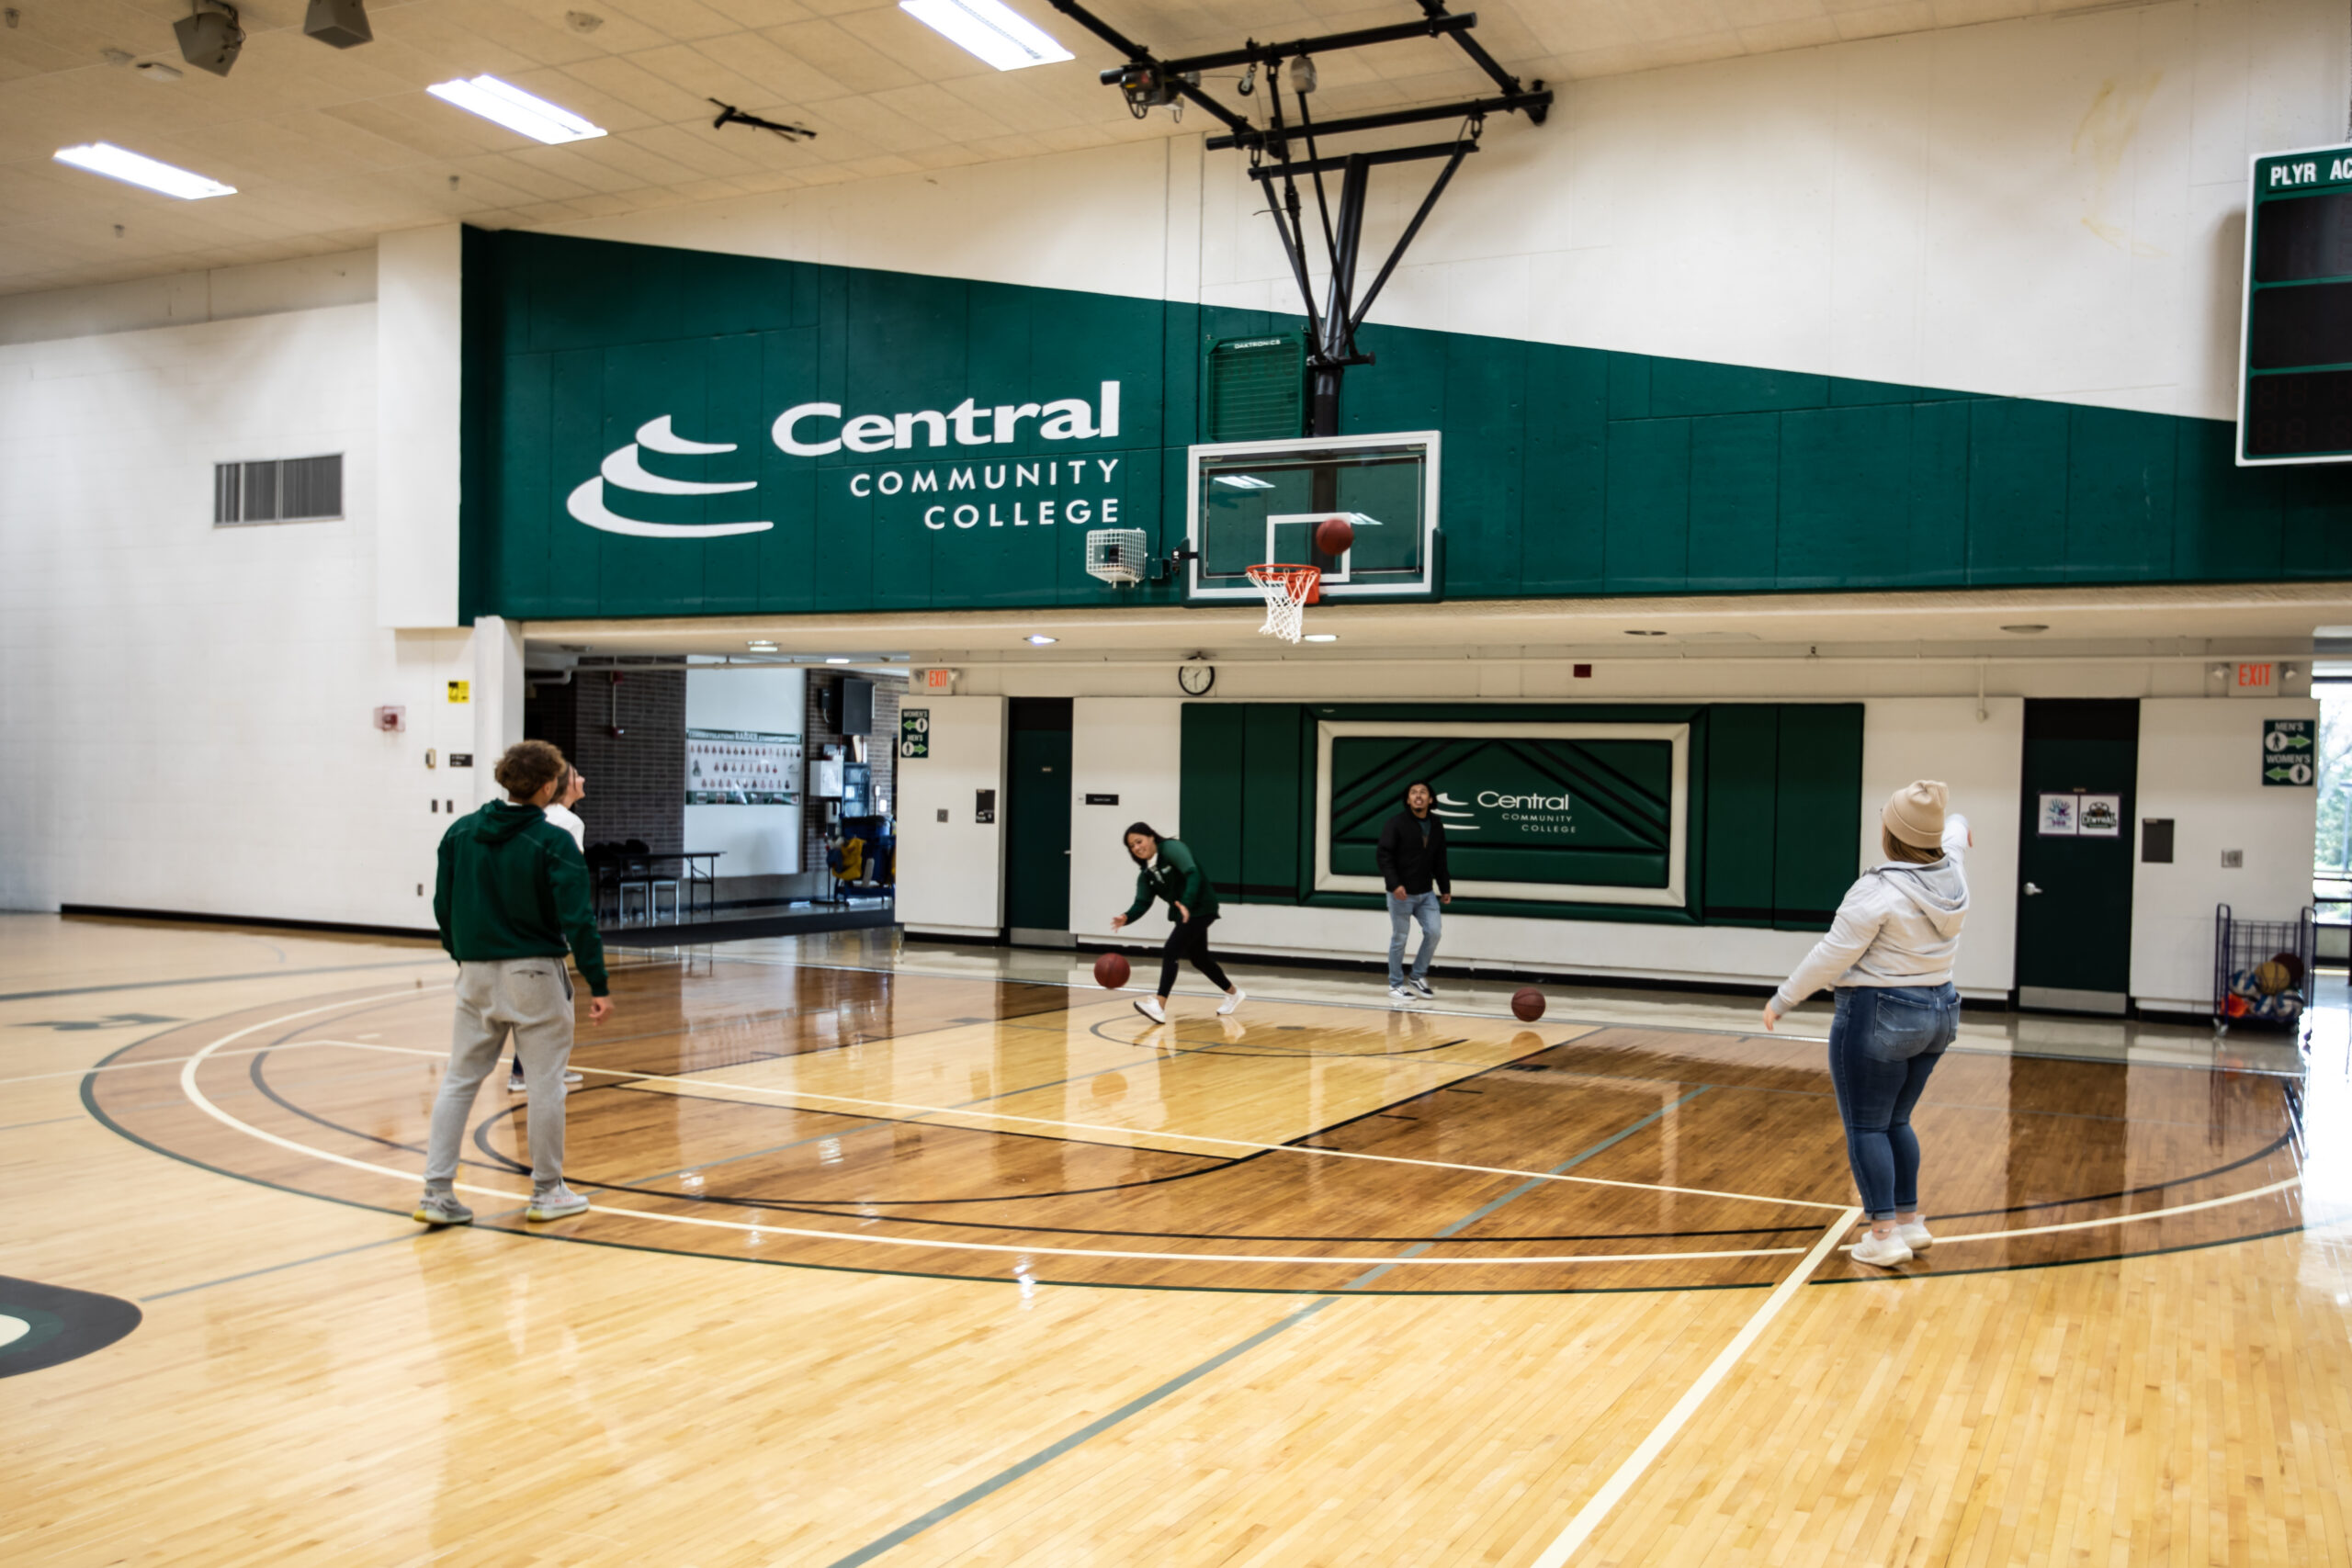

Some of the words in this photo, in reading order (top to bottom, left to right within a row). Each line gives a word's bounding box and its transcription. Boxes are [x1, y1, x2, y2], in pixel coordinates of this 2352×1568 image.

[2270, 162, 2317, 186] PLYR
[1235, 339, 1281, 349] DAKTRONICS
[772, 380, 1120, 457] Central
[850, 459, 1118, 497] COMMUNITY
[924, 499, 1118, 530] COLLEGE
[929, 670, 948, 687] EXIT
[2239, 663, 2271, 686] EXIT
[2275, 722, 2303, 731] MEN'S
[2266, 754, 2312, 763] WOMEN'S
[1477, 791, 1569, 810] Central
[1501, 812, 1572, 822] COMMUNITY
[1521, 824, 1577, 833] COLLEGE
